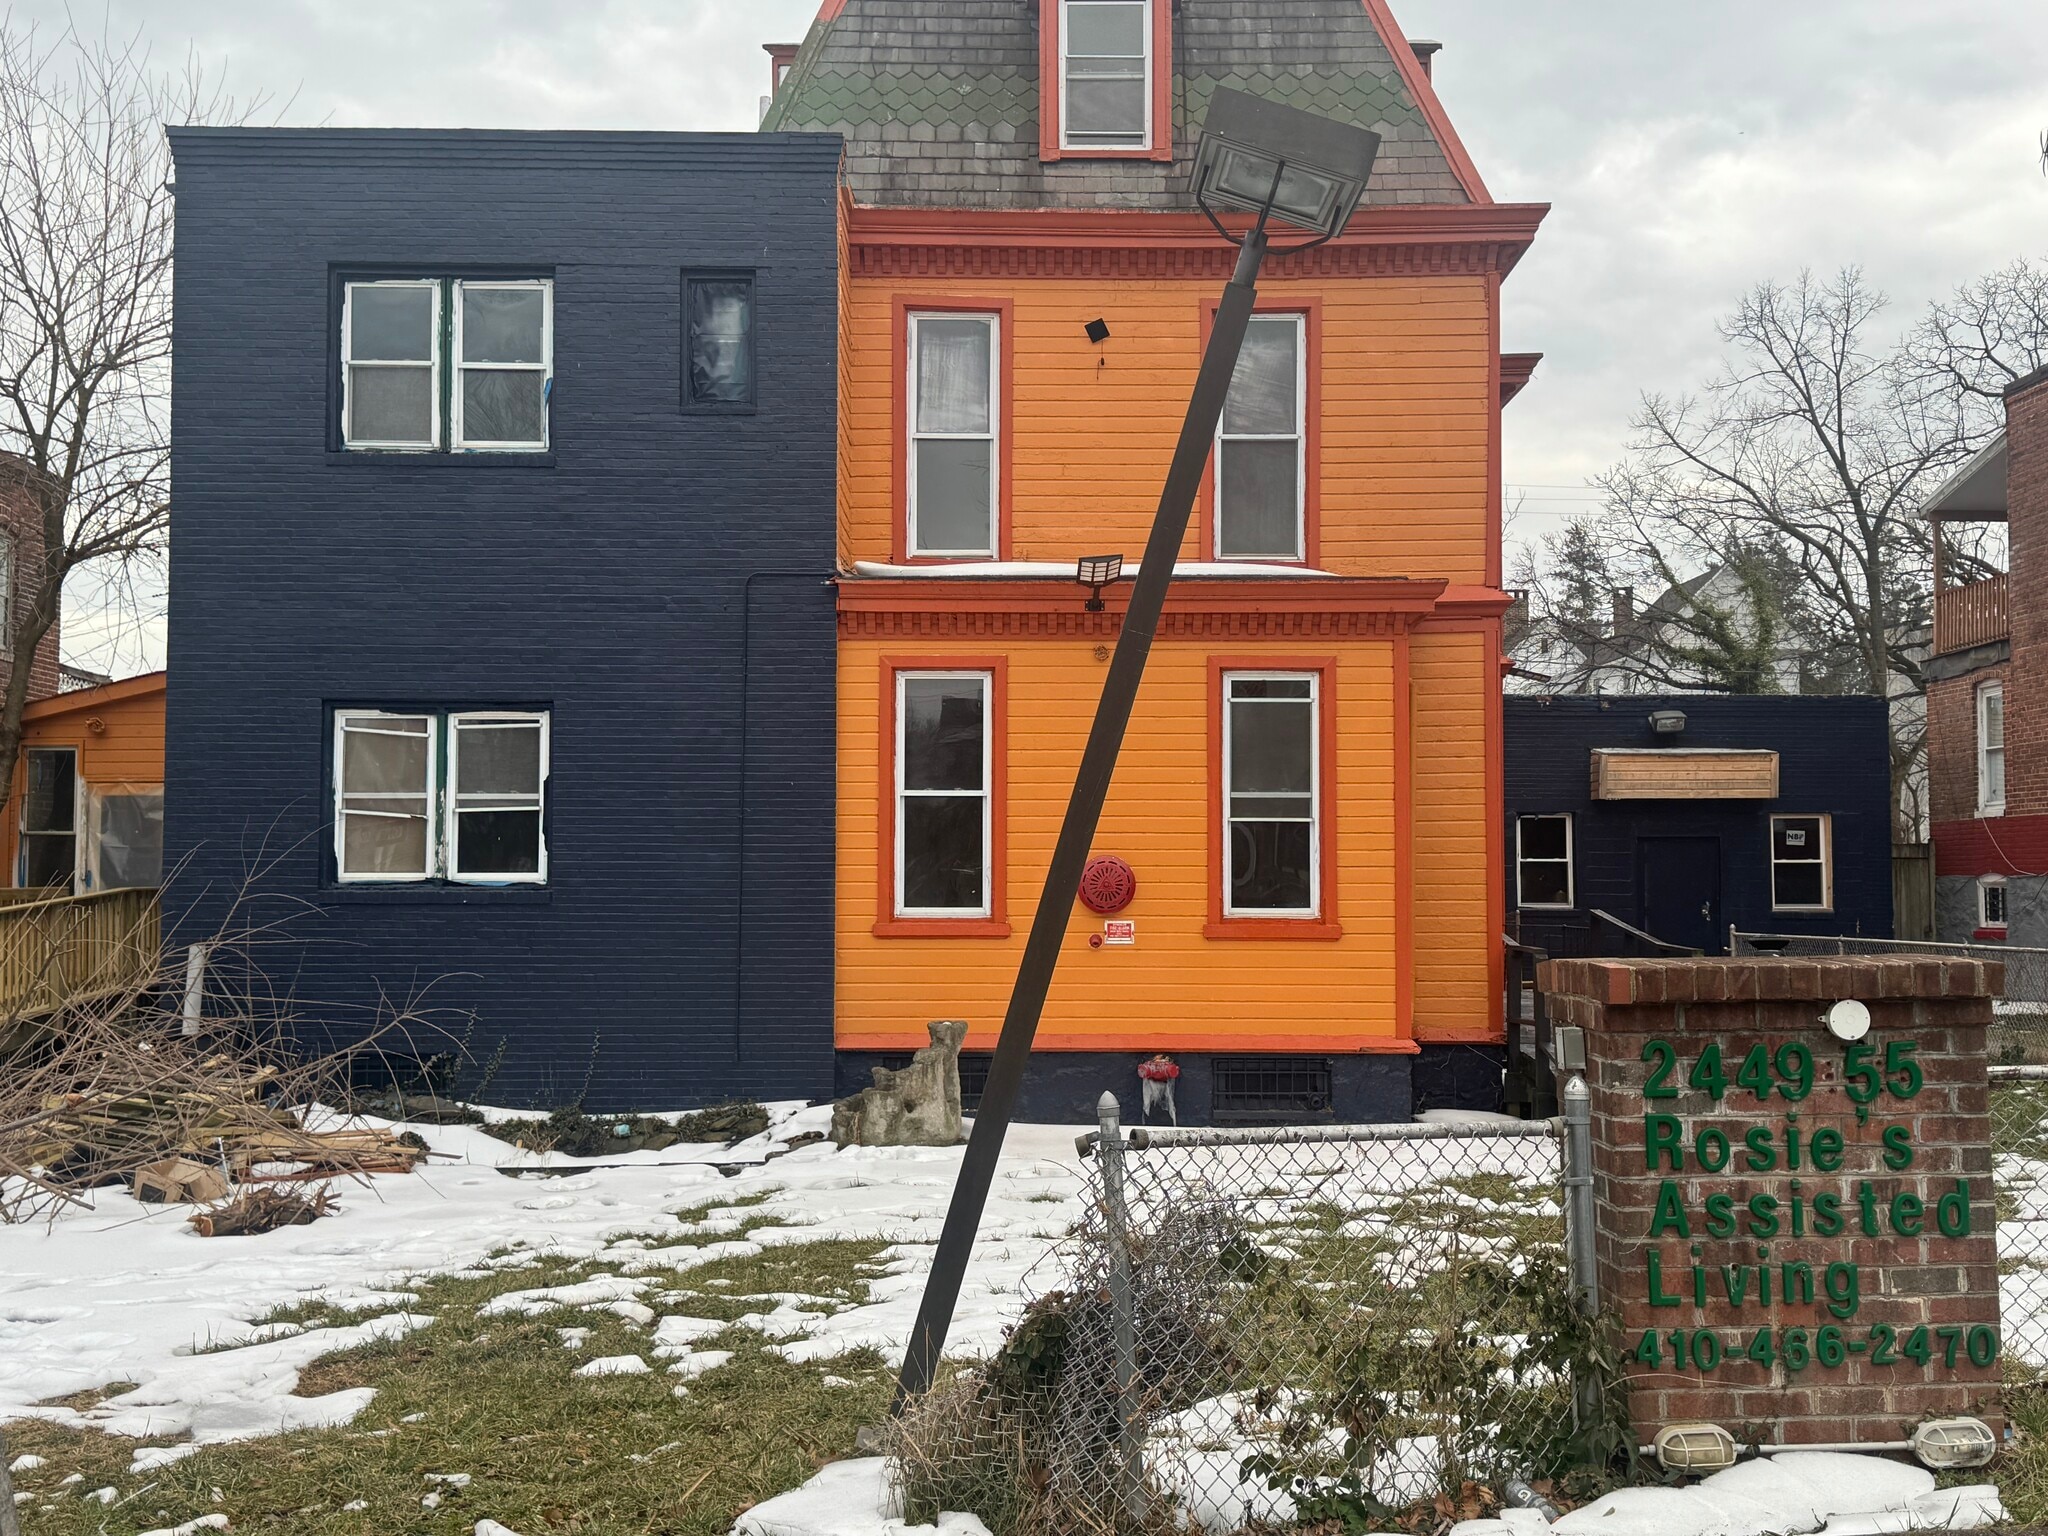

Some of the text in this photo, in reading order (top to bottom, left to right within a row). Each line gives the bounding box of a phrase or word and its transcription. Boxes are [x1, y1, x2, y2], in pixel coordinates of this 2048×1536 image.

[1641, 1039, 1924, 1103] 2449 55
[1644, 1106, 1915, 1172] Rosie's
[1650, 1178, 1971, 1239] Assisted
[1646, 1245, 1859, 1319] Living
[1636, 1323, 1997, 1372] 410-466-2470
